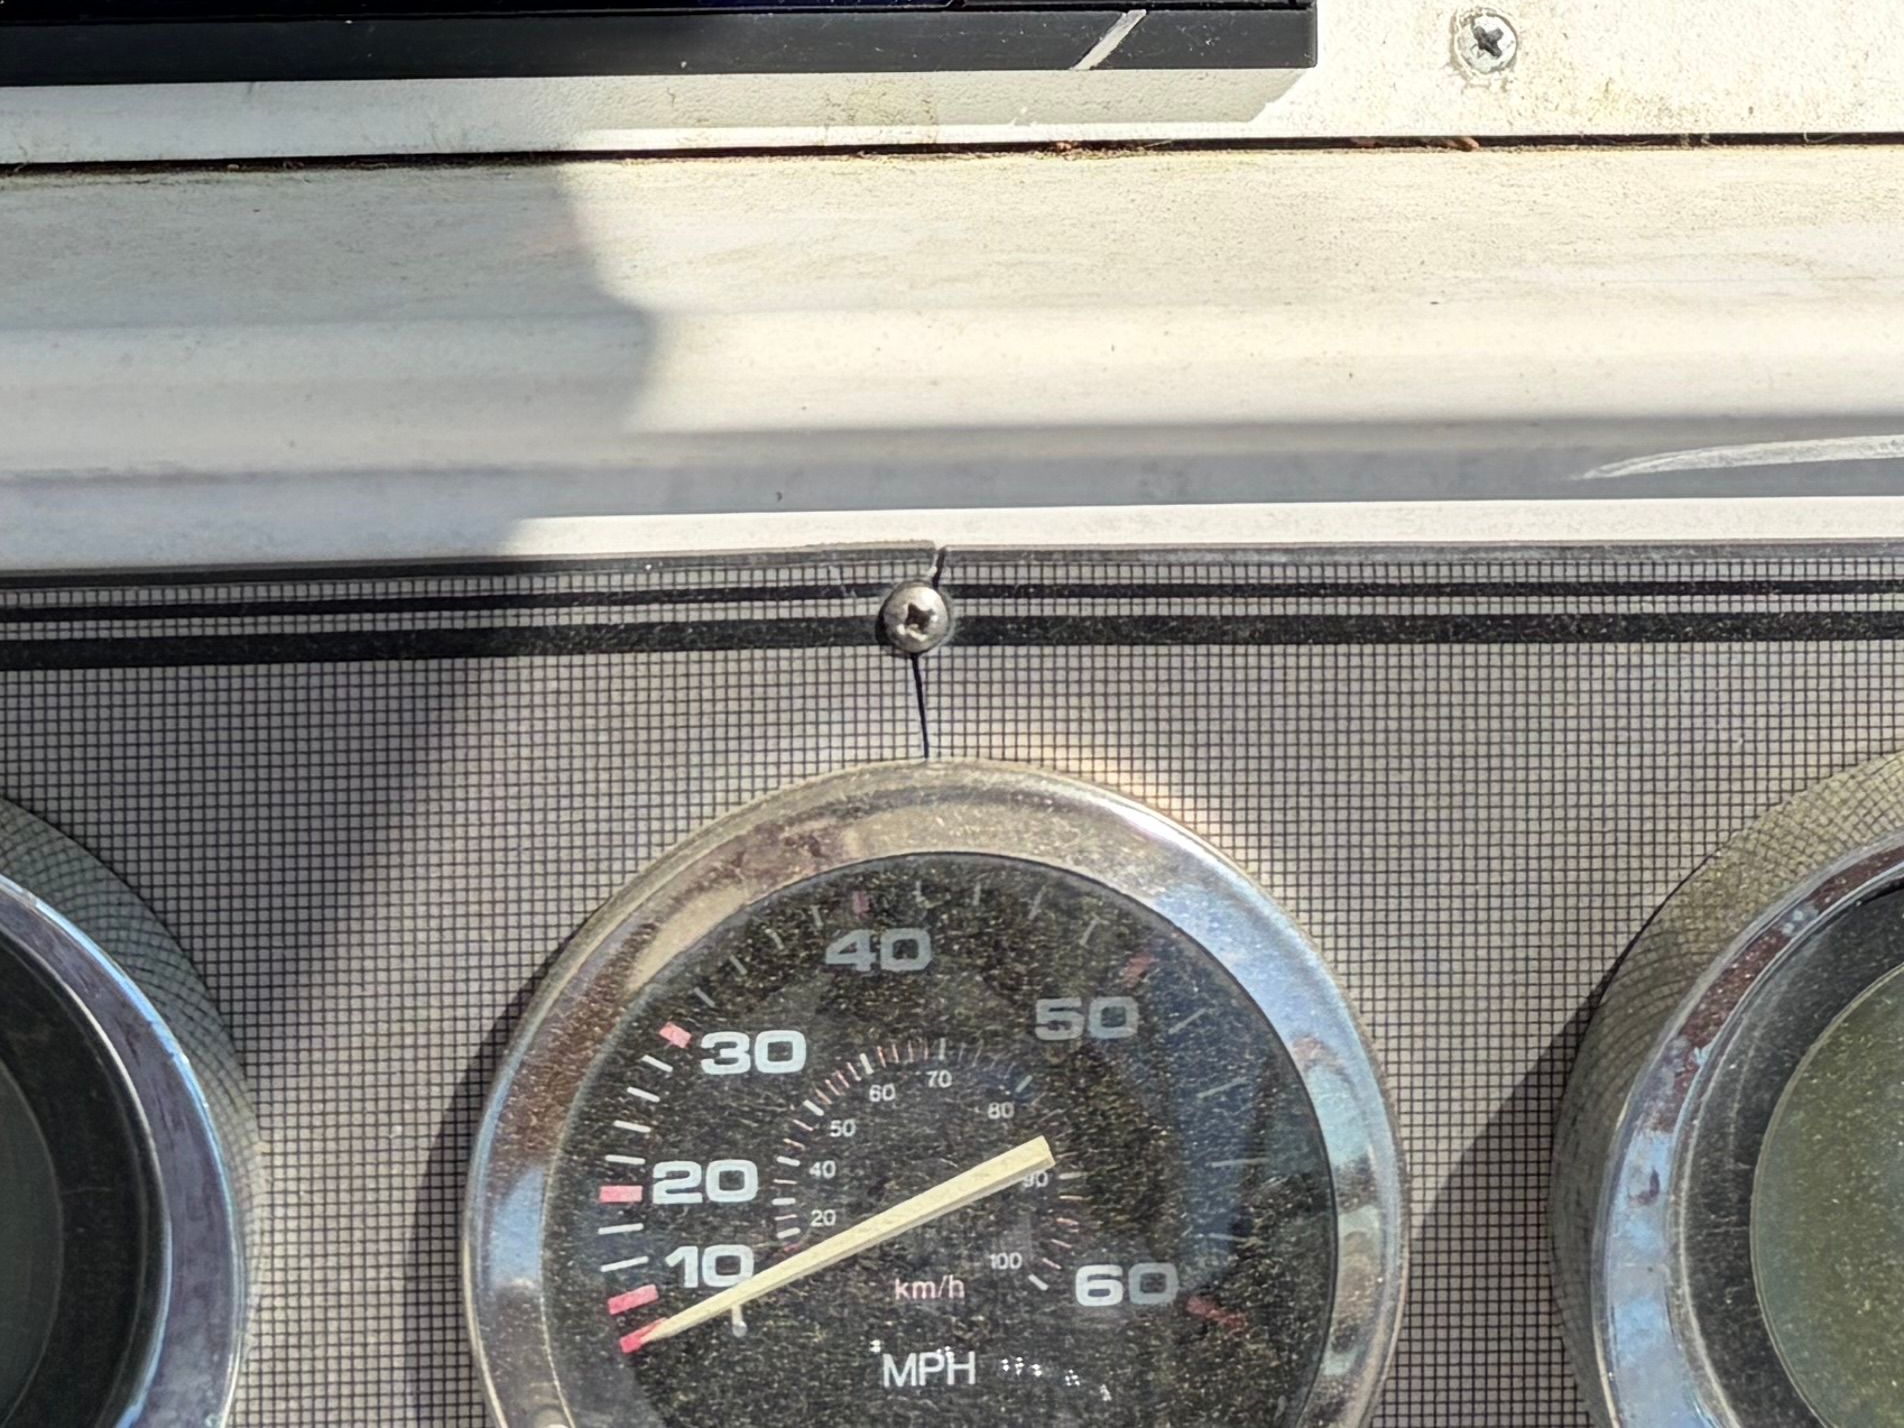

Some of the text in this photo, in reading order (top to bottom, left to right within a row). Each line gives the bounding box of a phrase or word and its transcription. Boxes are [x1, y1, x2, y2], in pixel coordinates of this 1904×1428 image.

[825, 928, 933, 971] 40
[1034, 997, 1140, 1040] 50
[701, 1030, 807, 1075] 30
[926, 1070, 952, 1088] 70
[869, 1084, 895, 1102] 60
[987, 1103, 1014, 1120] 80
[829, 1120, 856, 1138] 50
[809, 1160, 836, 1179] 40
[1023, 1171, 1049, 1189] 90
[652, 1159, 758, 1204] 20
[810, 1209, 837, 1227] 20
[665, 1244, 755, 1288] 10
[990, 1252, 1022, 1270] 100
[895, 1275, 965, 1300] km/h
[1075, 1262, 1179, 1306] 60
[883, 1351, 976, 1388] MPH
